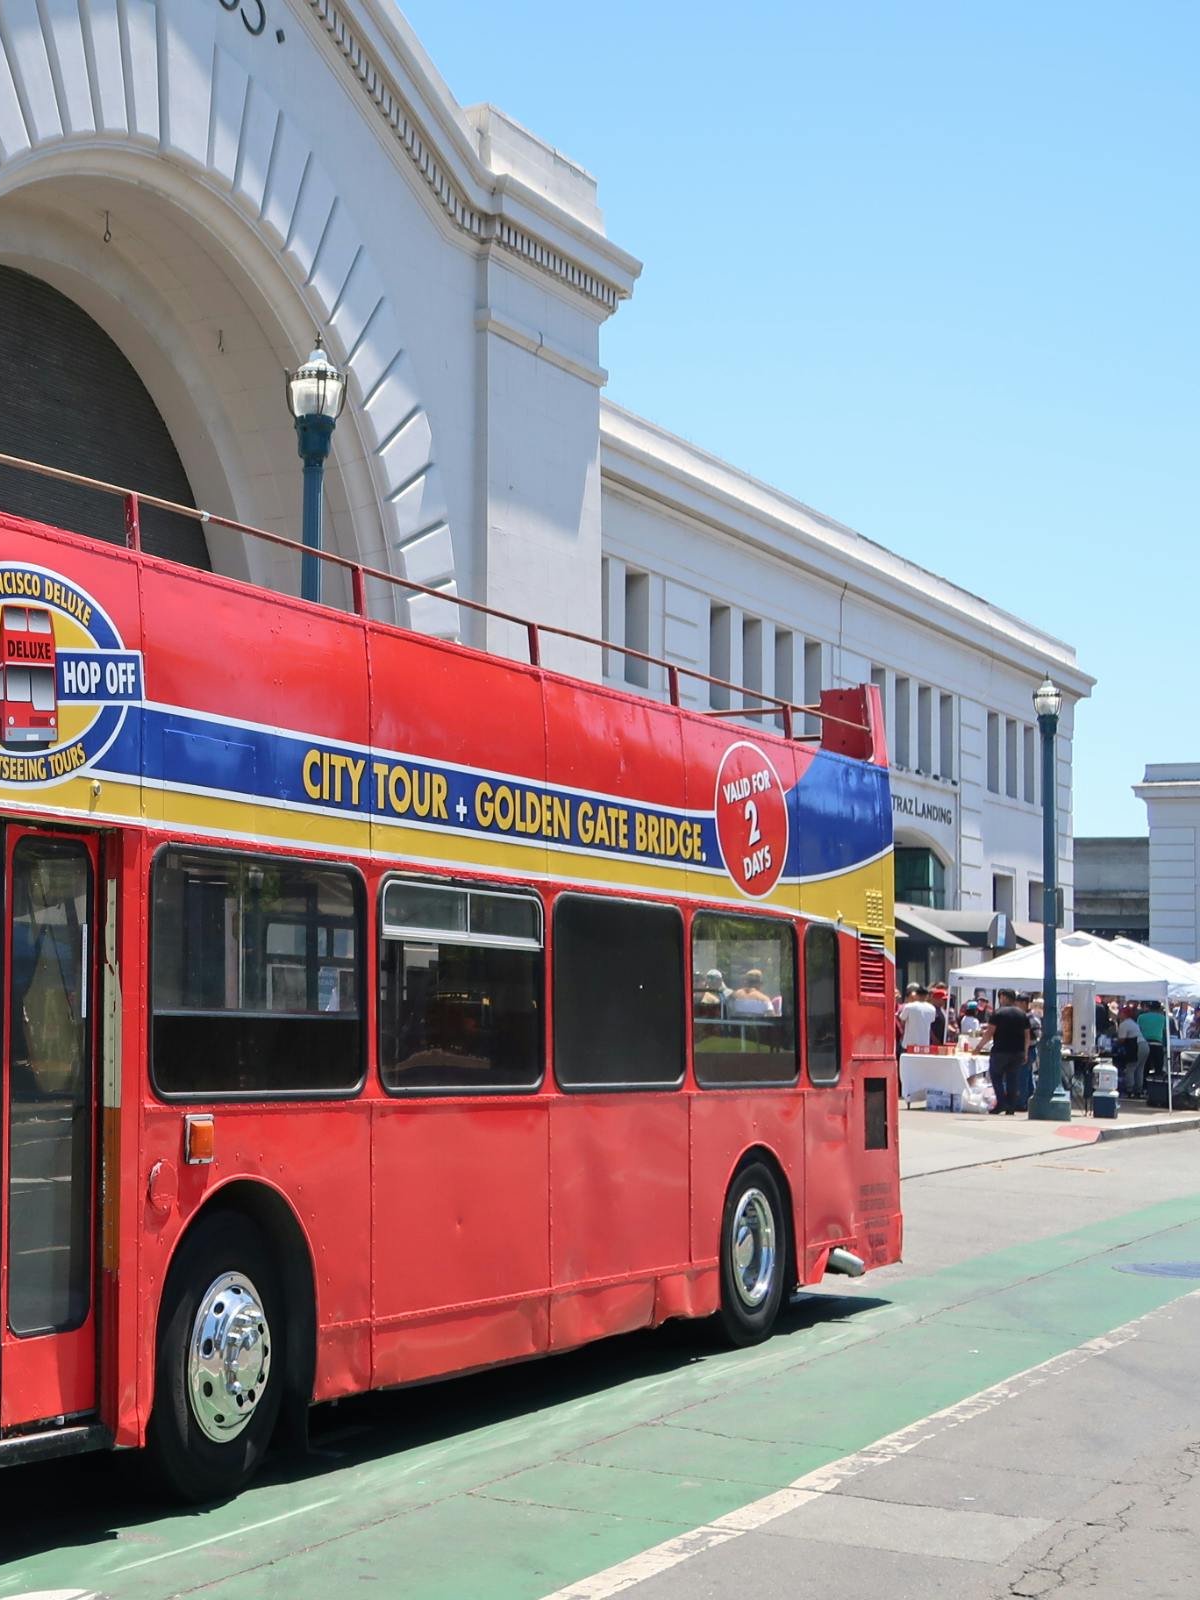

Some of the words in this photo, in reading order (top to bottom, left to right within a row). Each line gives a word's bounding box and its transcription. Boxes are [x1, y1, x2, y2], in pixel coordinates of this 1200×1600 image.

[44, 580, 92, 627] DELUXE
[7, 639, 51, 660] DELUXE
[63, 660, 101, 695] HOP
[105, 661, 136, 695] OFF
[48, 742, 86, 779] TOURS
[722, 776, 751, 805] VALID
[751, 769, 772, 794] FOR
[303, 749, 366, 805] CITY
[372, 762, 449, 820] TOUR
[474, 781, 571, 840] GOLDEN
[577, 801, 629, 849] GATE
[635, 812, 707, 863] BRIDGE.
[744, 800, 761, 847] 2
[743, 845, 772, 881] DAYS
